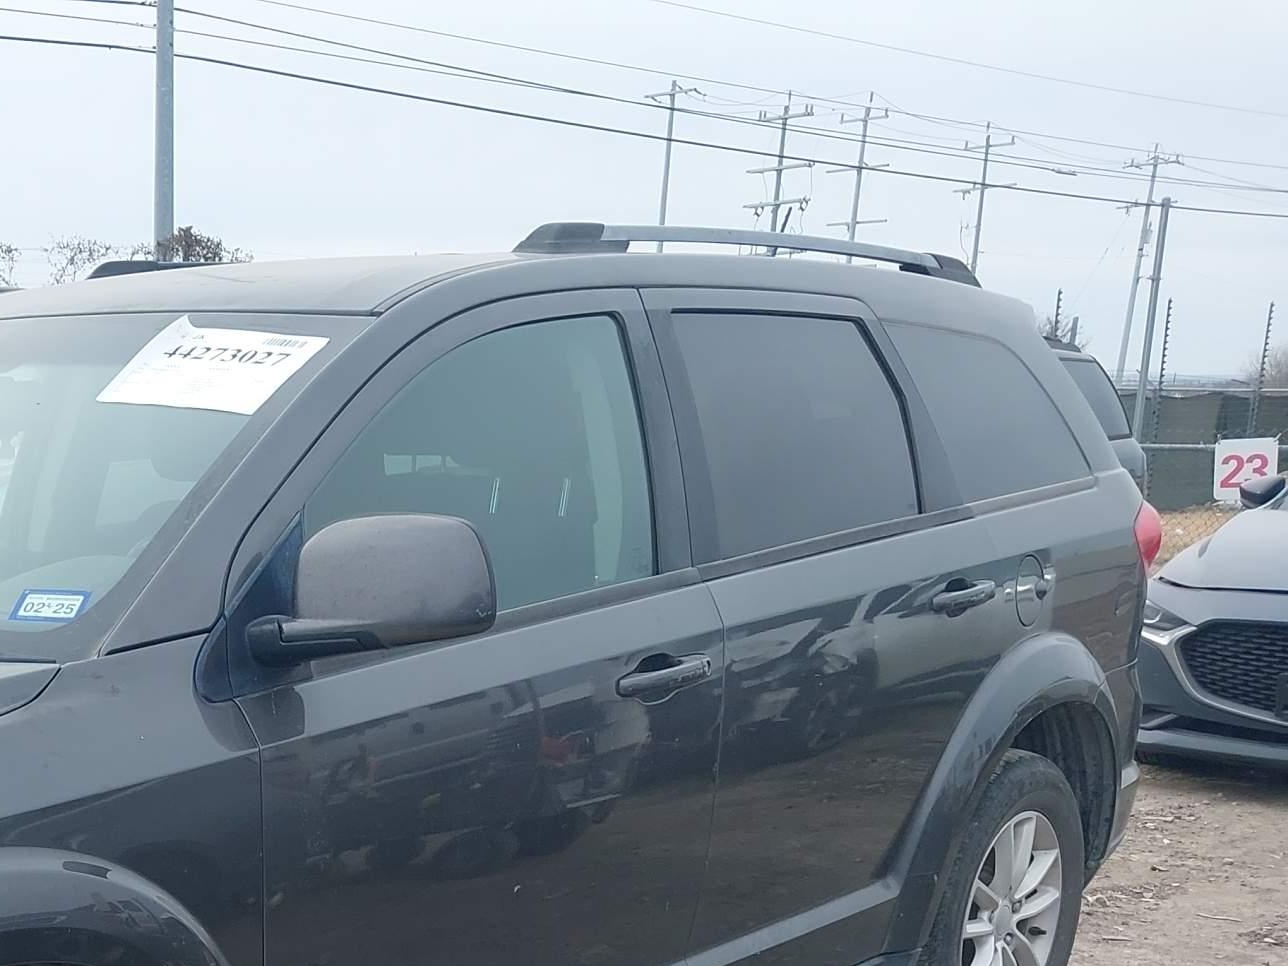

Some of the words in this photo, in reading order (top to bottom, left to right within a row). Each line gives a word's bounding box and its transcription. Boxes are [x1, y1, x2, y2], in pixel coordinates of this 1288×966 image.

[163, 344, 292, 367] 44273027
[1219, 453, 1269, 489] 23
[23, 602, 45, 613] 02
[52, 602, 76, 615] 25
